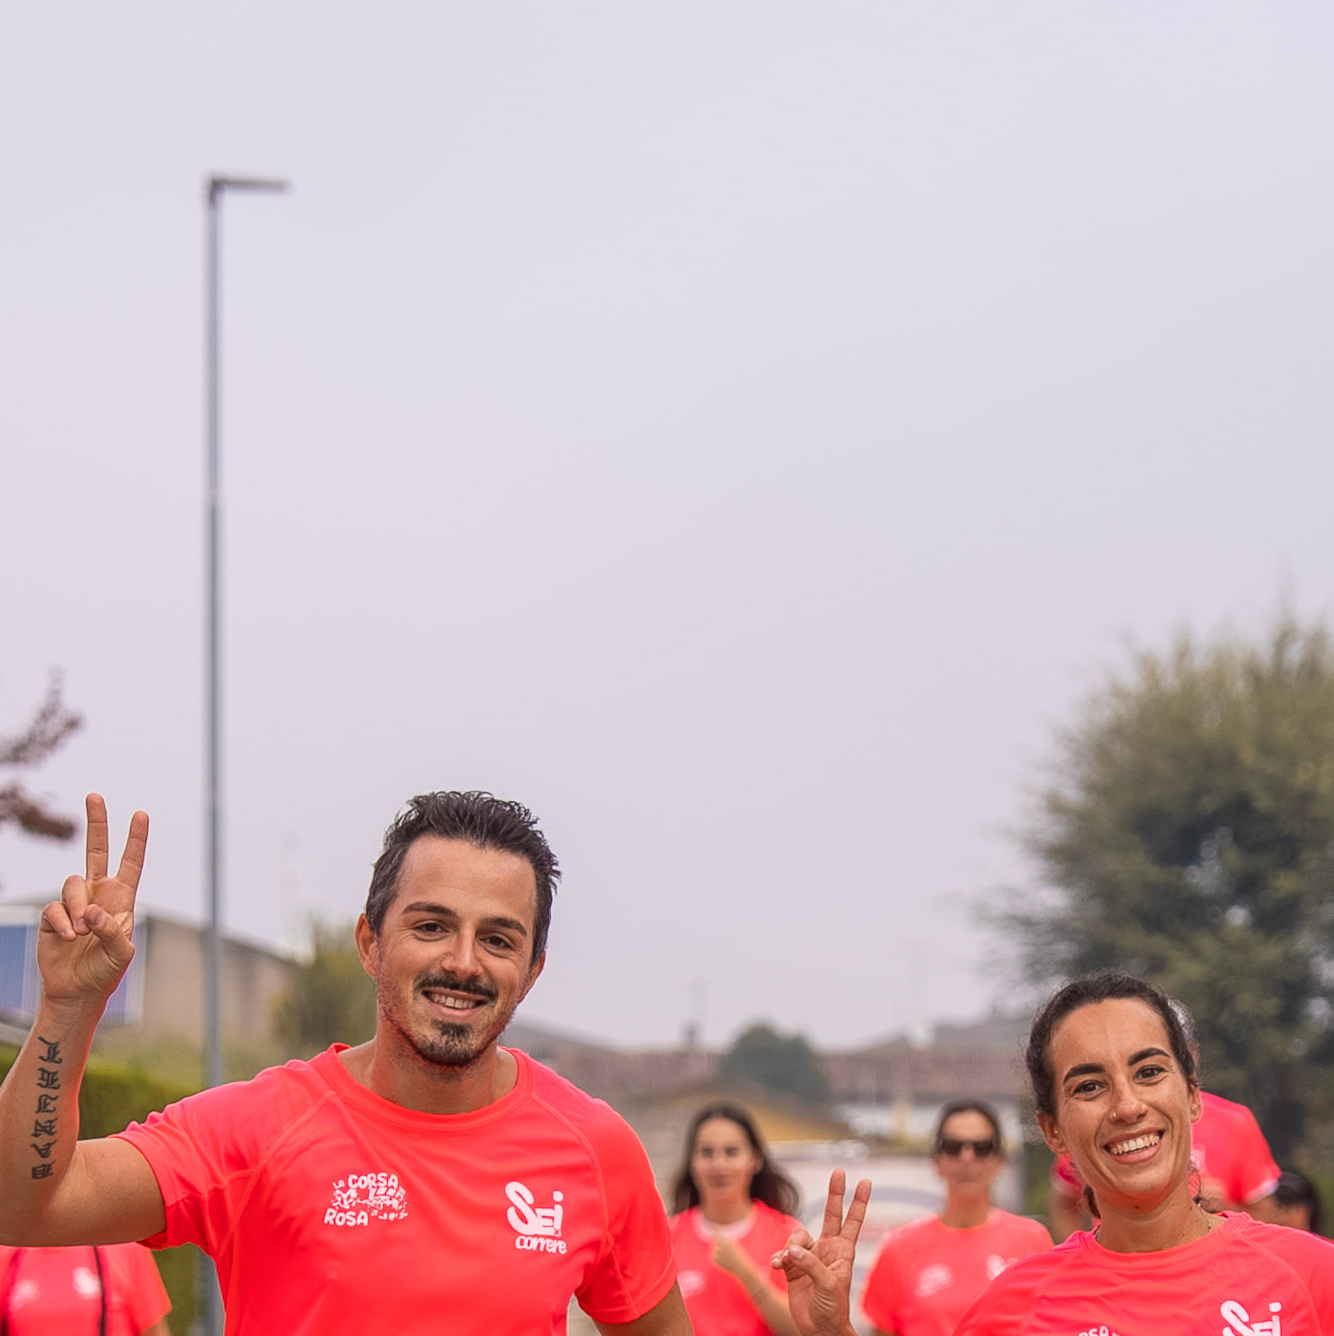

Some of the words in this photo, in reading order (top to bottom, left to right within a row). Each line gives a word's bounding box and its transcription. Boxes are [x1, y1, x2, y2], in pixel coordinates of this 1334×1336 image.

[347, 1172, 399, 1189] CORSA
[323, 1208, 369, 1227] ROSA
[515, 1235, 567, 1255] correre
